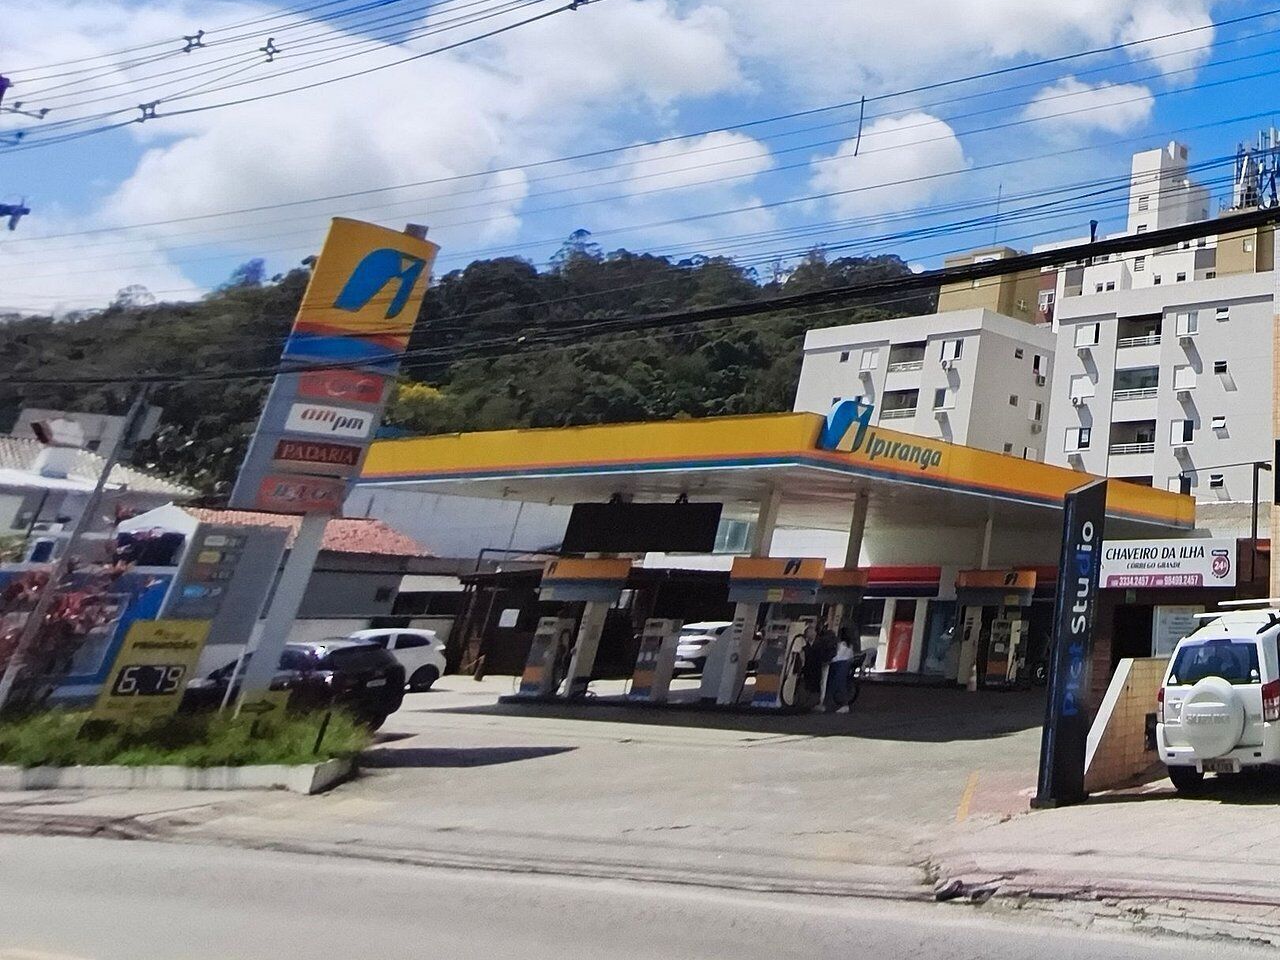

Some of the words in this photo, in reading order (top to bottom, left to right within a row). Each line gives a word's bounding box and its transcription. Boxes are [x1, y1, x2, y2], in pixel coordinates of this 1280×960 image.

[300, 408, 364, 431] ampm
[280, 443, 354, 462] PADARIA
[865, 431, 942, 470] Ipiranga
[1105, 546, 1158, 561] CHAVEIRO
[1161, 546, 1176, 559] DA
[1179, 545, 1205, 559] ILHA
[1070, 520, 1094, 635] Studio
[116, 665, 186, 696] 6,79
